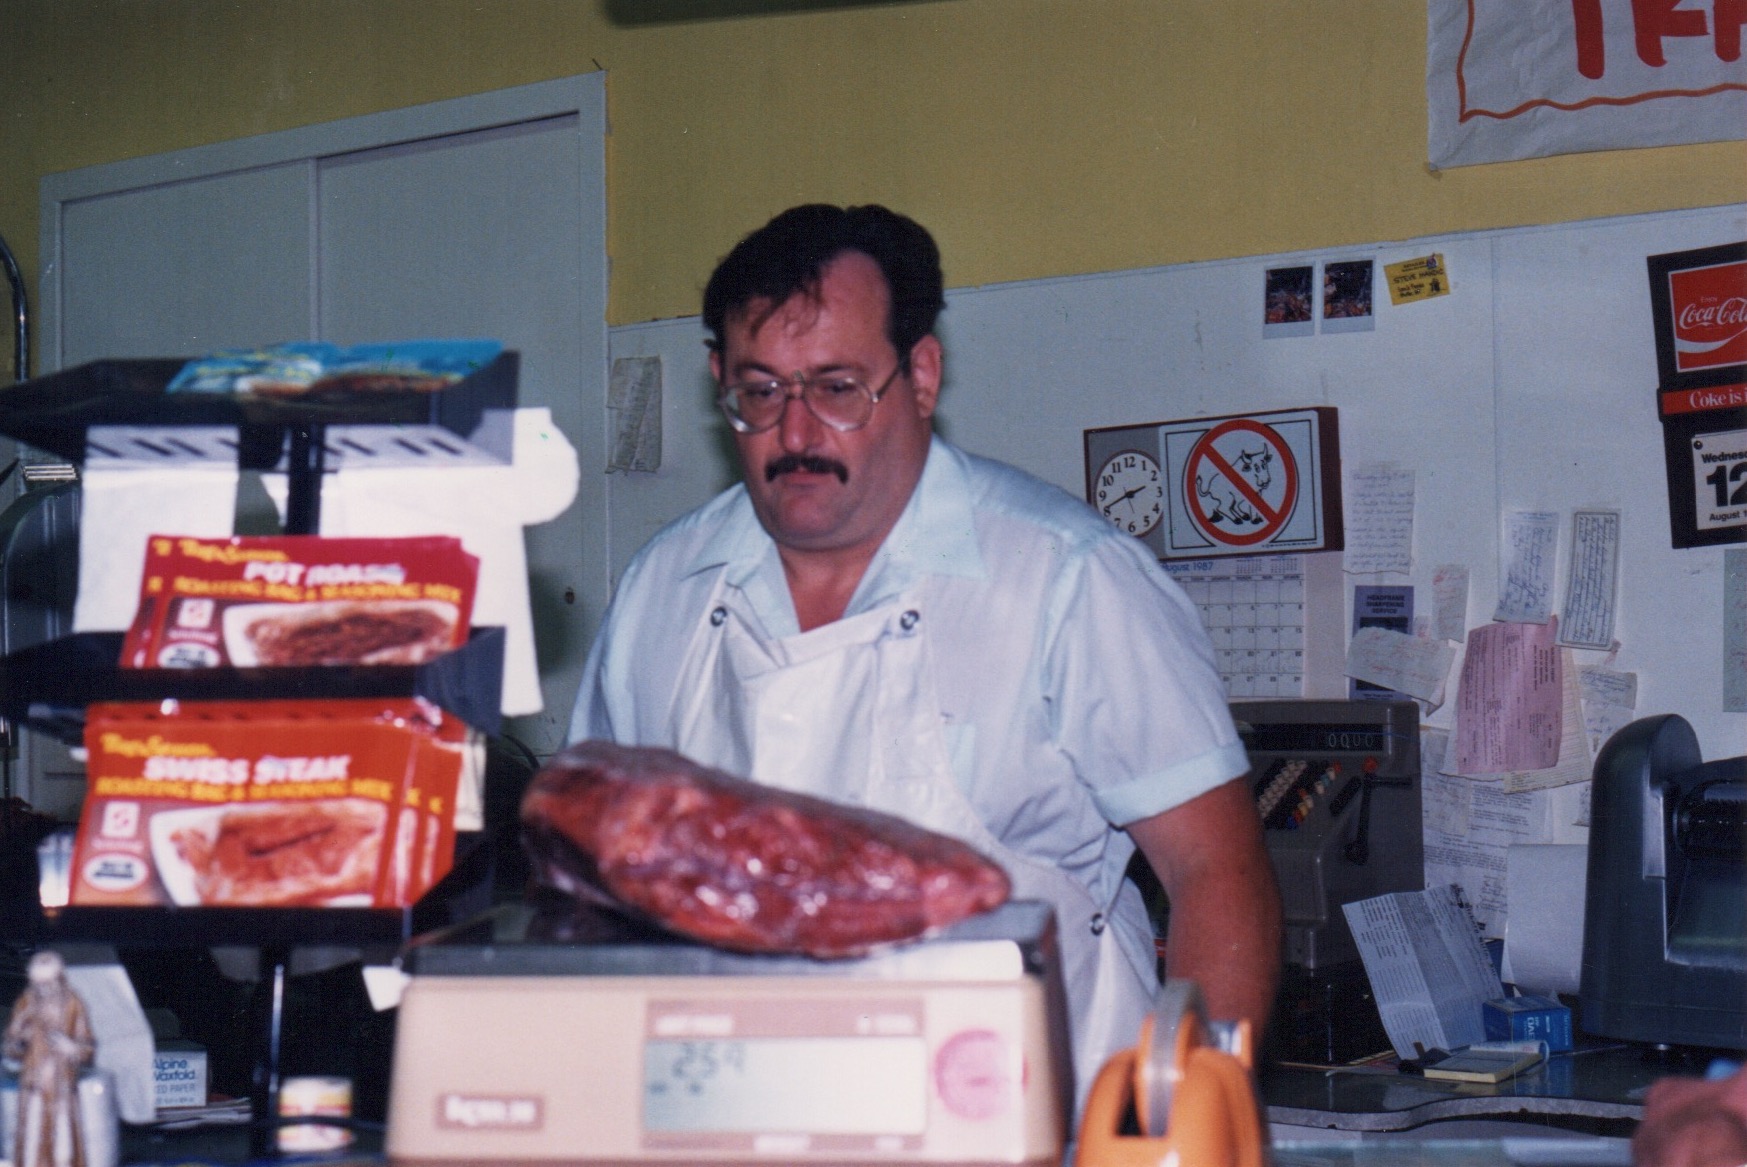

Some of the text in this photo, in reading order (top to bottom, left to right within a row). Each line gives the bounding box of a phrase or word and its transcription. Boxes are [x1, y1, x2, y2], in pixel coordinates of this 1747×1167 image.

[1690, 391, 1727, 408] Coke
[1729, 389, 1742, 404] is
[1112, 462, 1121, 473] 11
[1123, 456, 1136, 468] 12
[1141, 460, 1147, 471] 1
[1102, 475, 1114, 487] 10
[1151, 470, 1157, 481] 2
[1706, 461, 1747, 507] 12
[1099, 490, 1107, 501] 9
[1156, 486, 1163, 497] 3
[1103, 506, 1111, 517] 8
[1152, 503, 1159, 514] 4
[1143, 516, 1150, 527] 5
[1709, 510, 1740, 522] August
[1114, 517, 1121, 528] 7
[1128, 521, 1136, 532] 6
[1193, 561, 1214, 571] 1987
[243, 560, 305, 586] POT
[143, 754, 352, 785] SWISS STEAK
[154, 1058, 188, 1072] Alpine
